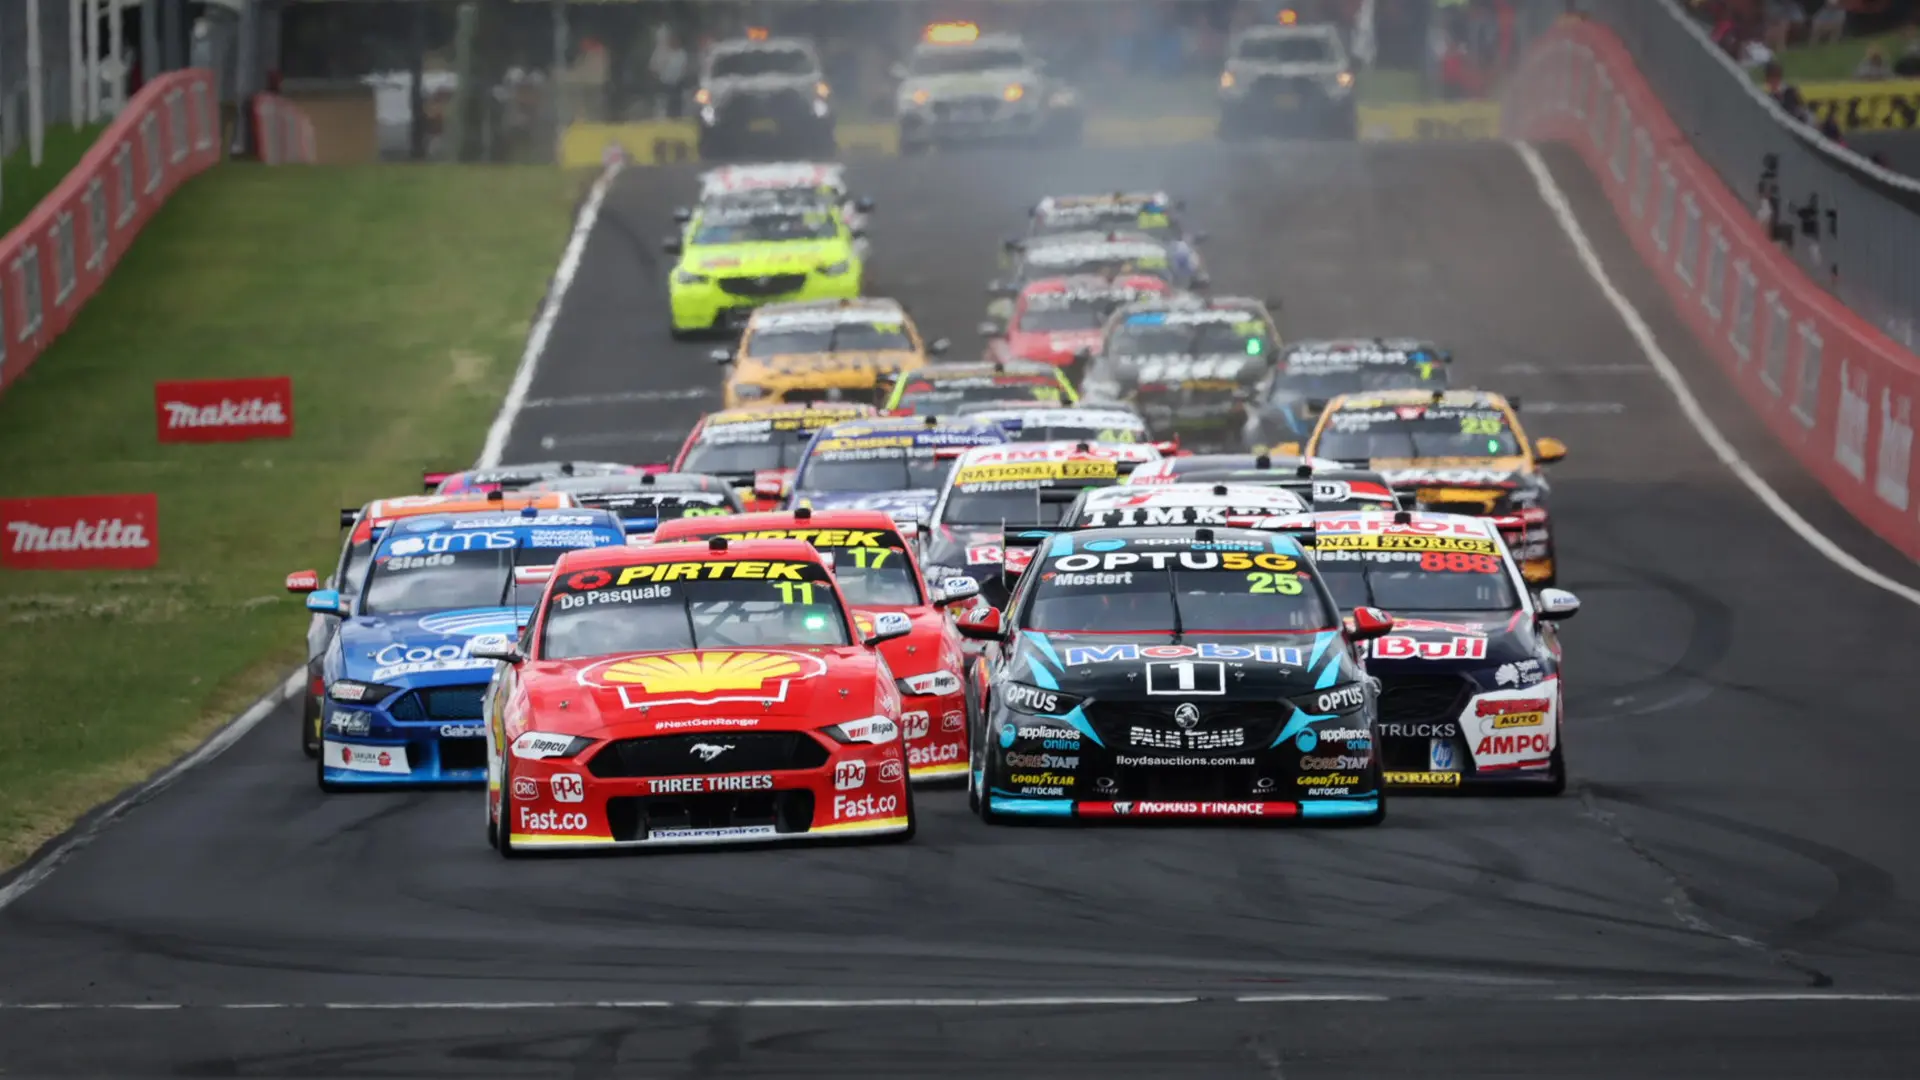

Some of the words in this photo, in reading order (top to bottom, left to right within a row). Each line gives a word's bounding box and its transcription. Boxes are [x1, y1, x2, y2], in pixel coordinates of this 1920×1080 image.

[962, 466, 1057, 481] NATIONAL
[425, 530, 517, 550] tms
[1382, 536, 1490, 552] STORAGE
[388, 553, 455, 571] Slade
[848, 547, 891, 569] 17
[1420, 551, 1500, 573] 888
[616, 562, 807, 585] PIRTEK
[1055, 572, 1133, 586] Mostert
[1247, 572, 1303, 595] 25
[561, 594, 585, 610] De
[587, 585, 672, 605] Pasquale
[774, 581, 814, 605] 11
[1066, 643, 1303, 666] Mobil
[1376, 637, 1487, 658] Bull
[1169, 660, 1196, 690] 1
[1007, 686, 1058, 712] OPTUS
[1318, 688, 1363, 712] OPTUS
[655, 717, 760, 730] #NextGenRanger
[1500, 714, 1538, 725] AUTO
[1018, 726, 1080, 740] appliances
[1378, 723, 1456, 737] TRUCKS
[531, 738, 567, 752] Repco
[1043, 739, 1080, 750] online
[1116, 755, 1255, 766] lloydsauctions.com.au
[648, 777, 704, 793] THREE
[708, 775, 773, 792] THREES
[1011, 772, 1075, 786] GOODYEAR
[1297, 772, 1359, 786] GOODYEAR
[515, 783, 535, 795] CRC
[1021, 787, 1064, 795] AUTOCARE
[1308, 787, 1349, 795] AUTOCARE
[833, 795, 897, 819] Fast.co
[520, 806, 588, 830] Fast.co
[652, 827, 770, 839] Beaurepaires
